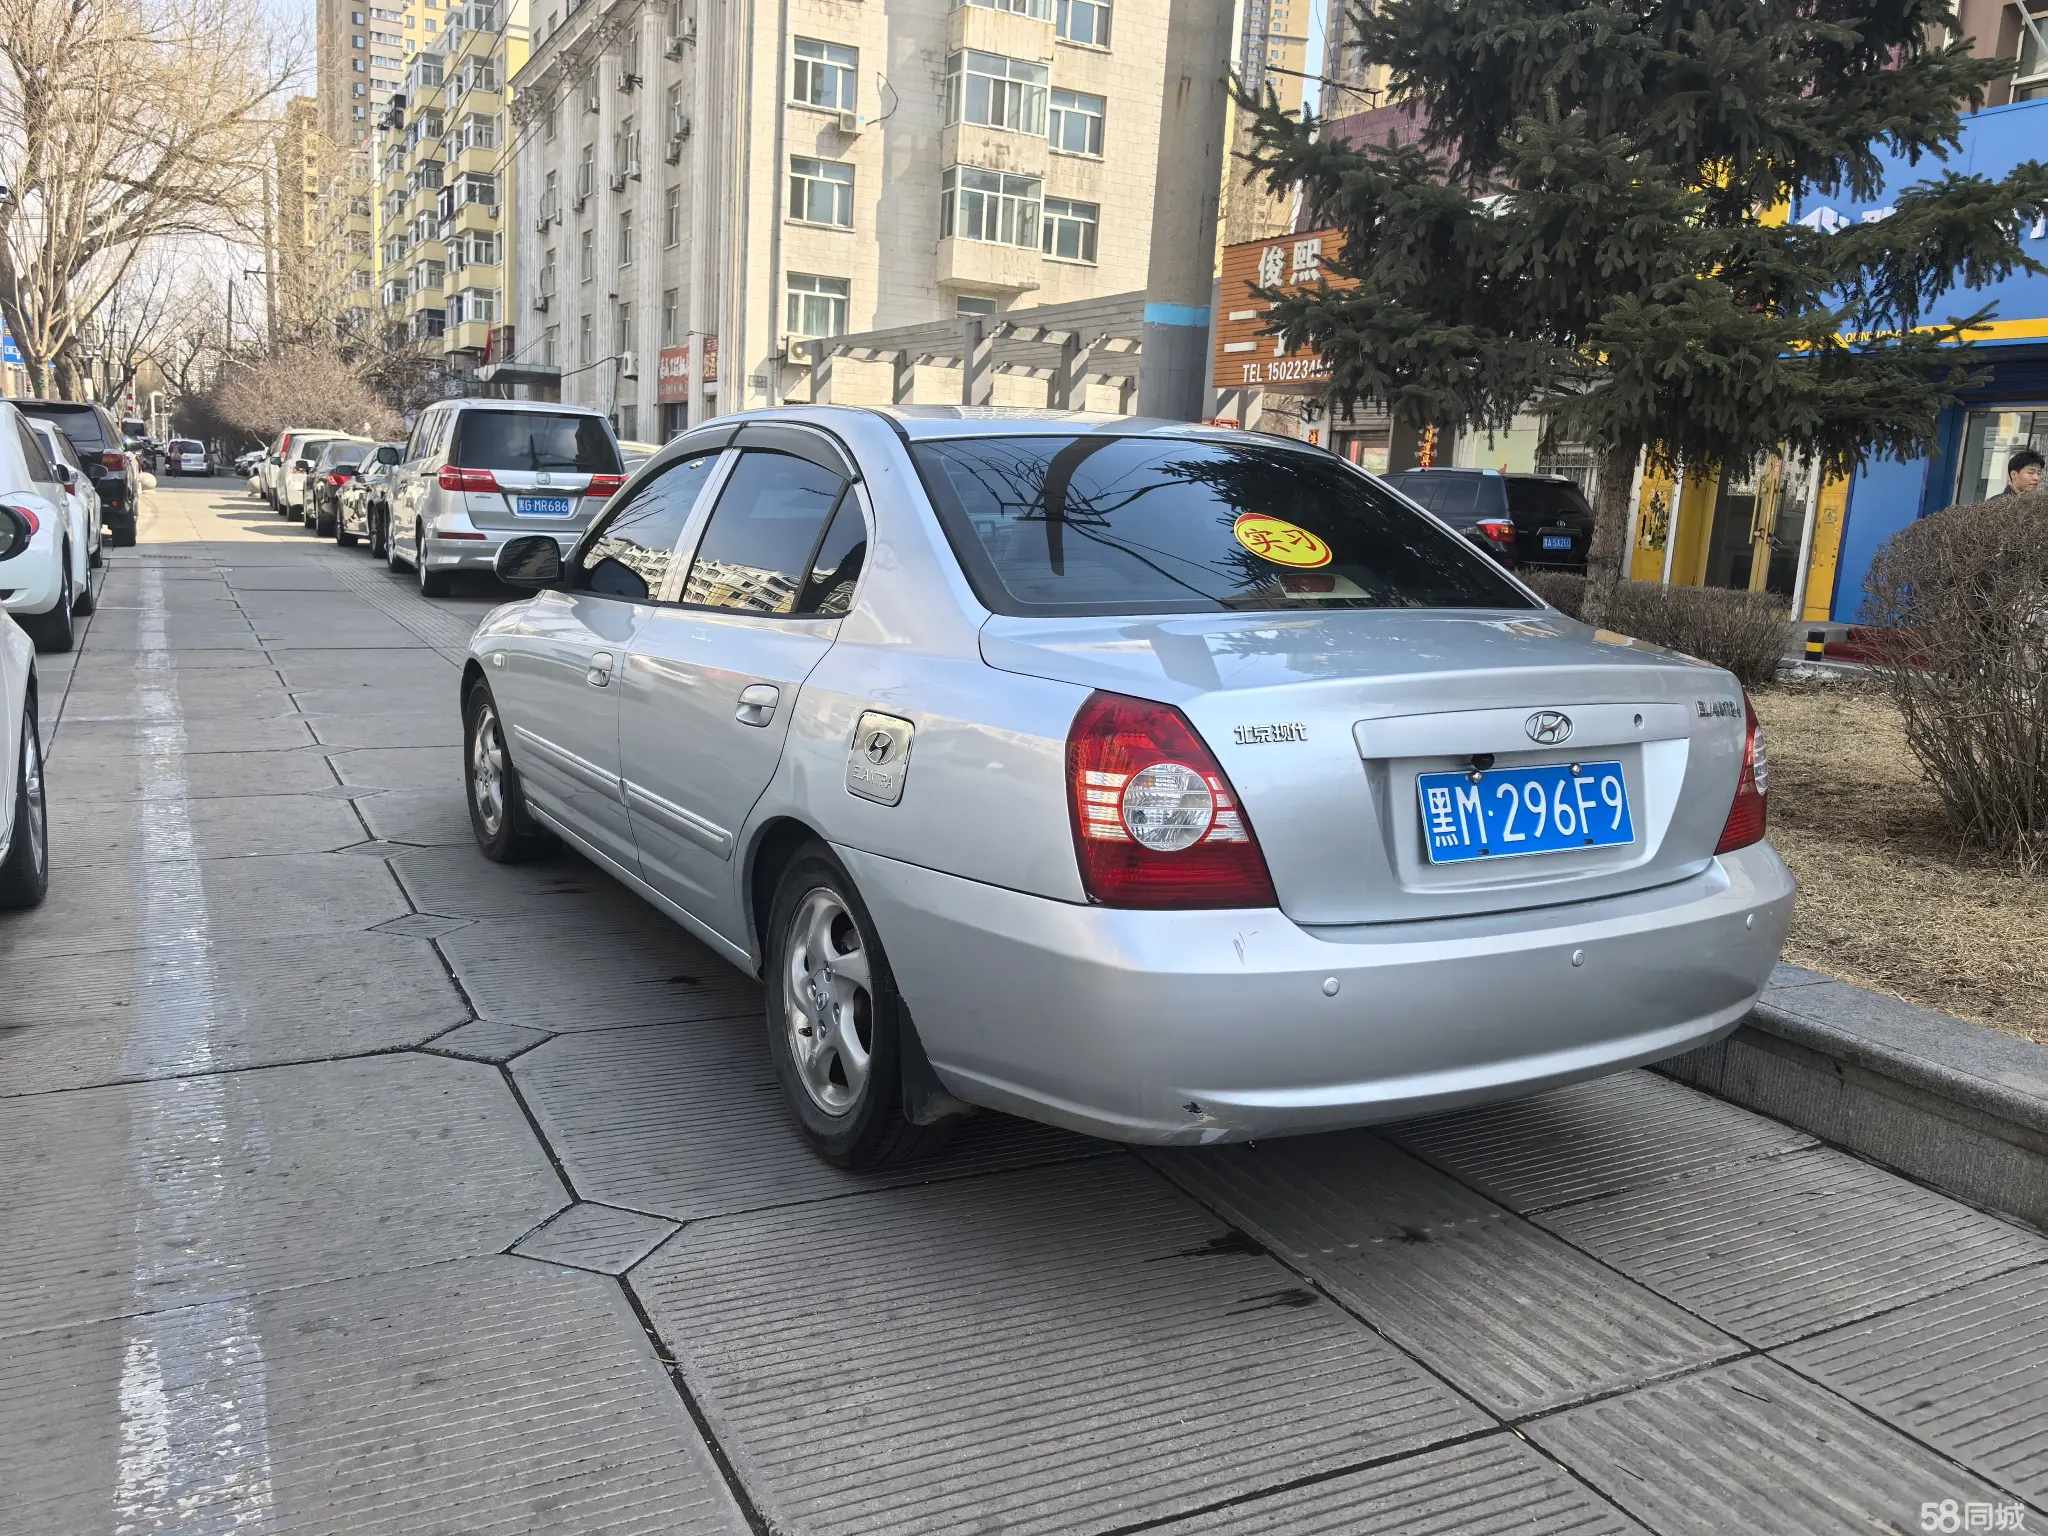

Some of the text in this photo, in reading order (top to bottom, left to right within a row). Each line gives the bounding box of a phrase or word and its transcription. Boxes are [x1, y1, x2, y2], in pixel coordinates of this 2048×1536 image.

[1258, 239, 1321, 289] 俊熙
[1243, 363, 1262, 382] TEL
[1244, 527, 1317, 554] 实习
[1234, 722, 1308, 745] 北京现代
[852, 765, 893, 789] ELANTRA
